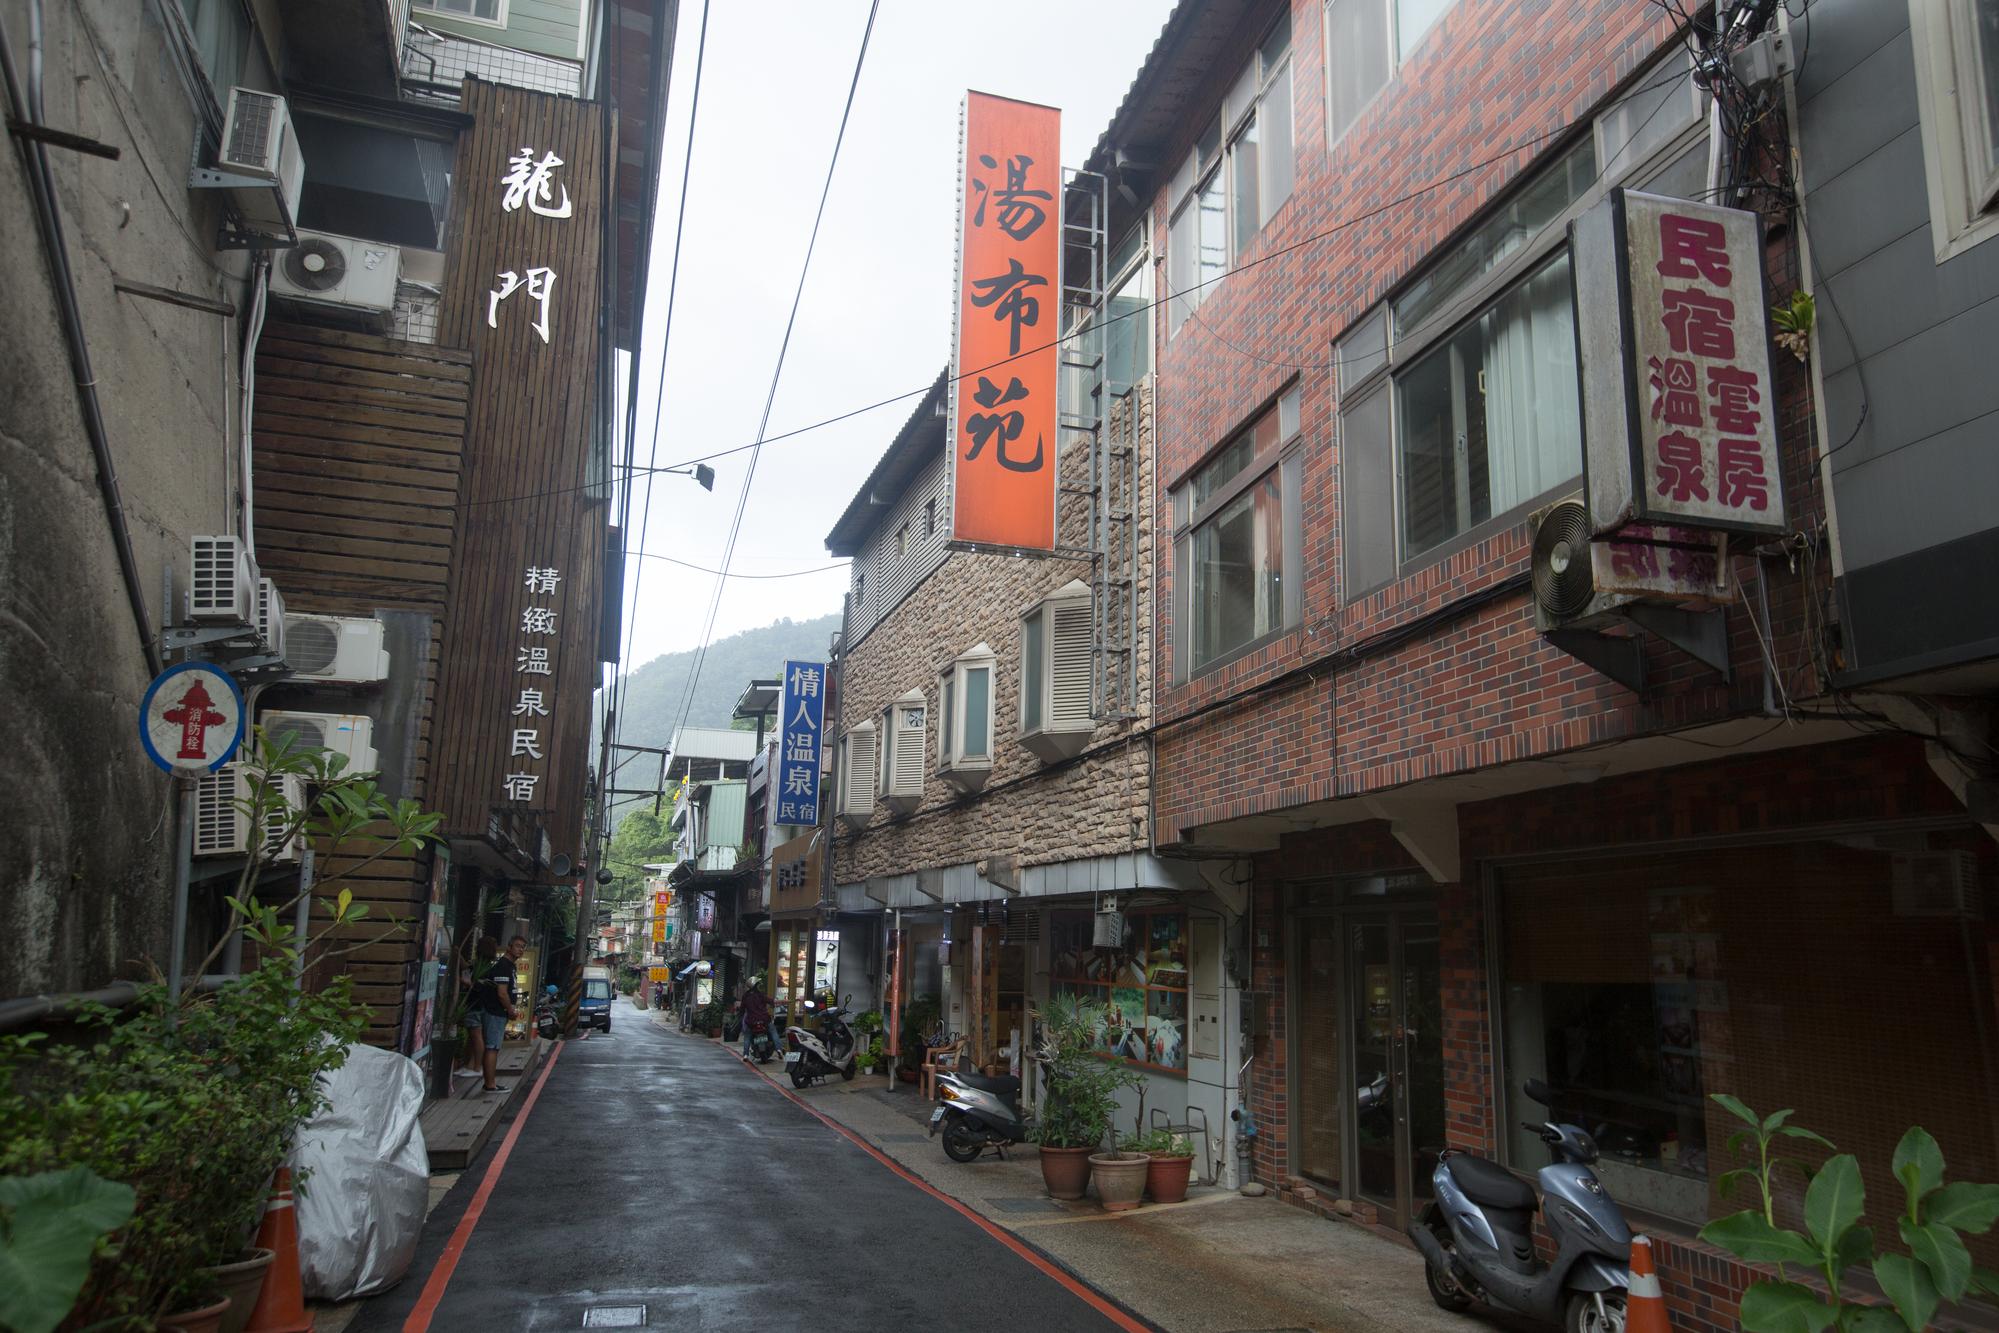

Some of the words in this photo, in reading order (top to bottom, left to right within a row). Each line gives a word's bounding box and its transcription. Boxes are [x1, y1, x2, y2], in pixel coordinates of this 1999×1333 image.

[488, 147, 573, 345] 龍門
[964, 154, 1054, 474] 湯布苑
[1656, 213, 1736, 361] 民宿
[1647, 355, 1710, 503] 溫泉
[1708, 365, 1768, 511] 套房
[187, 706, 203, 750] 消防栓
[503, 565, 562, 803] 精緻溫泉民宿
[784, 667, 821, 797] 情人温泉
[781, 802, 816, 821] 民宿
